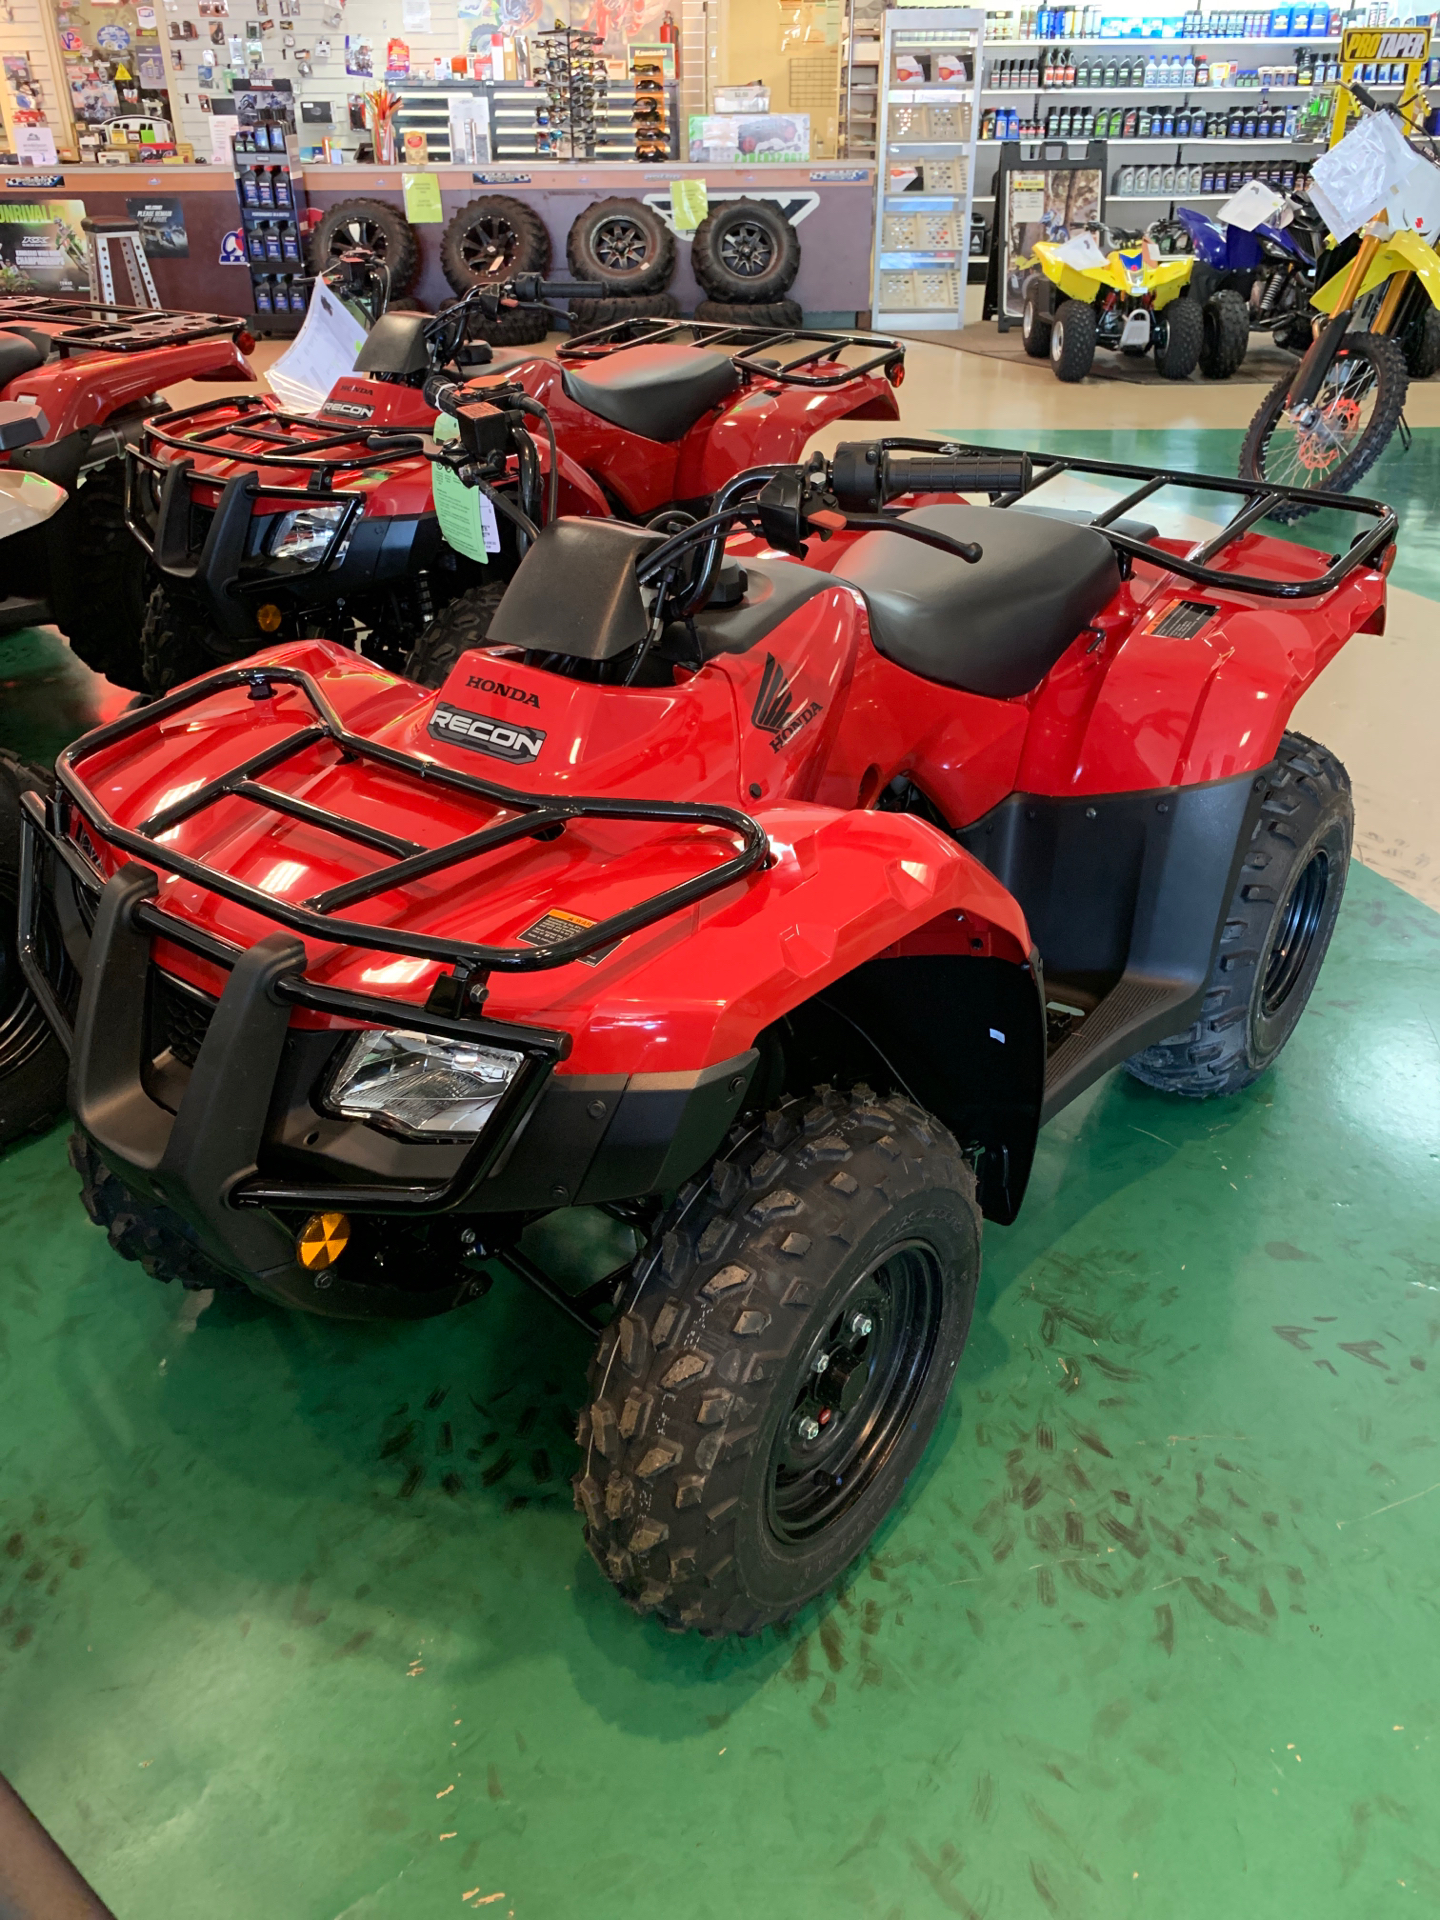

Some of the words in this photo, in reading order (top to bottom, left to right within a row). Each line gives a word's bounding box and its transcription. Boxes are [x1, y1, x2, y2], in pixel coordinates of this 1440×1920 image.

[341, 385, 374, 396] HONDA
[323, 402, 374, 418] RECON
[465, 675, 540, 709] HONDA
[429, 709, 544, 756] RECON
[769, 701, 824, 754] HONDA
